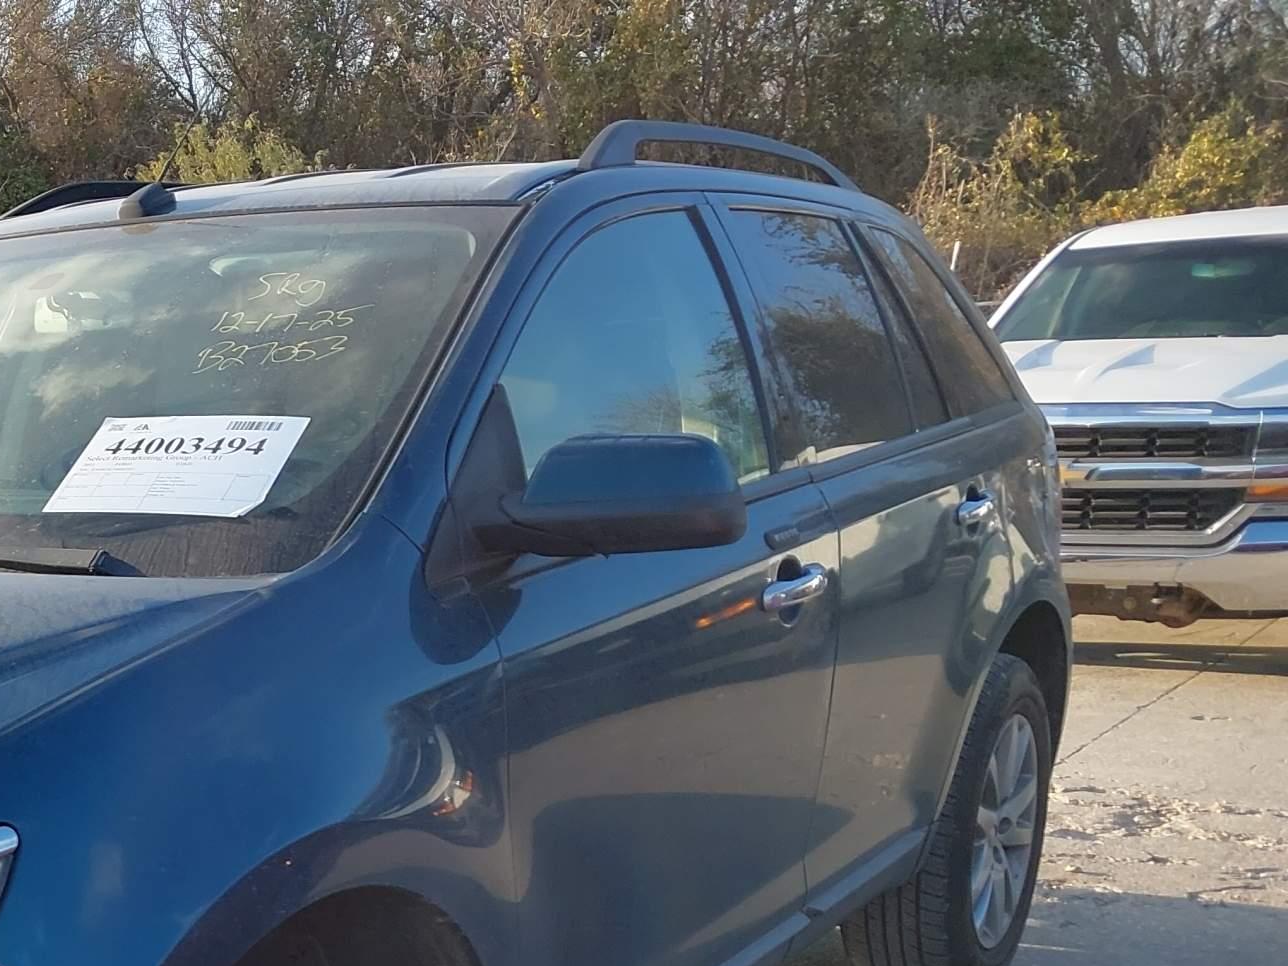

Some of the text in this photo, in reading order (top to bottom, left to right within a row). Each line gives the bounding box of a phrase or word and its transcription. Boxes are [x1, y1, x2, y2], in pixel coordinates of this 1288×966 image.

[211, 304, 375, 333] 12-17-25
[105, 437, 268, 455] 44003494
[165, 455, 192, 463] Group
